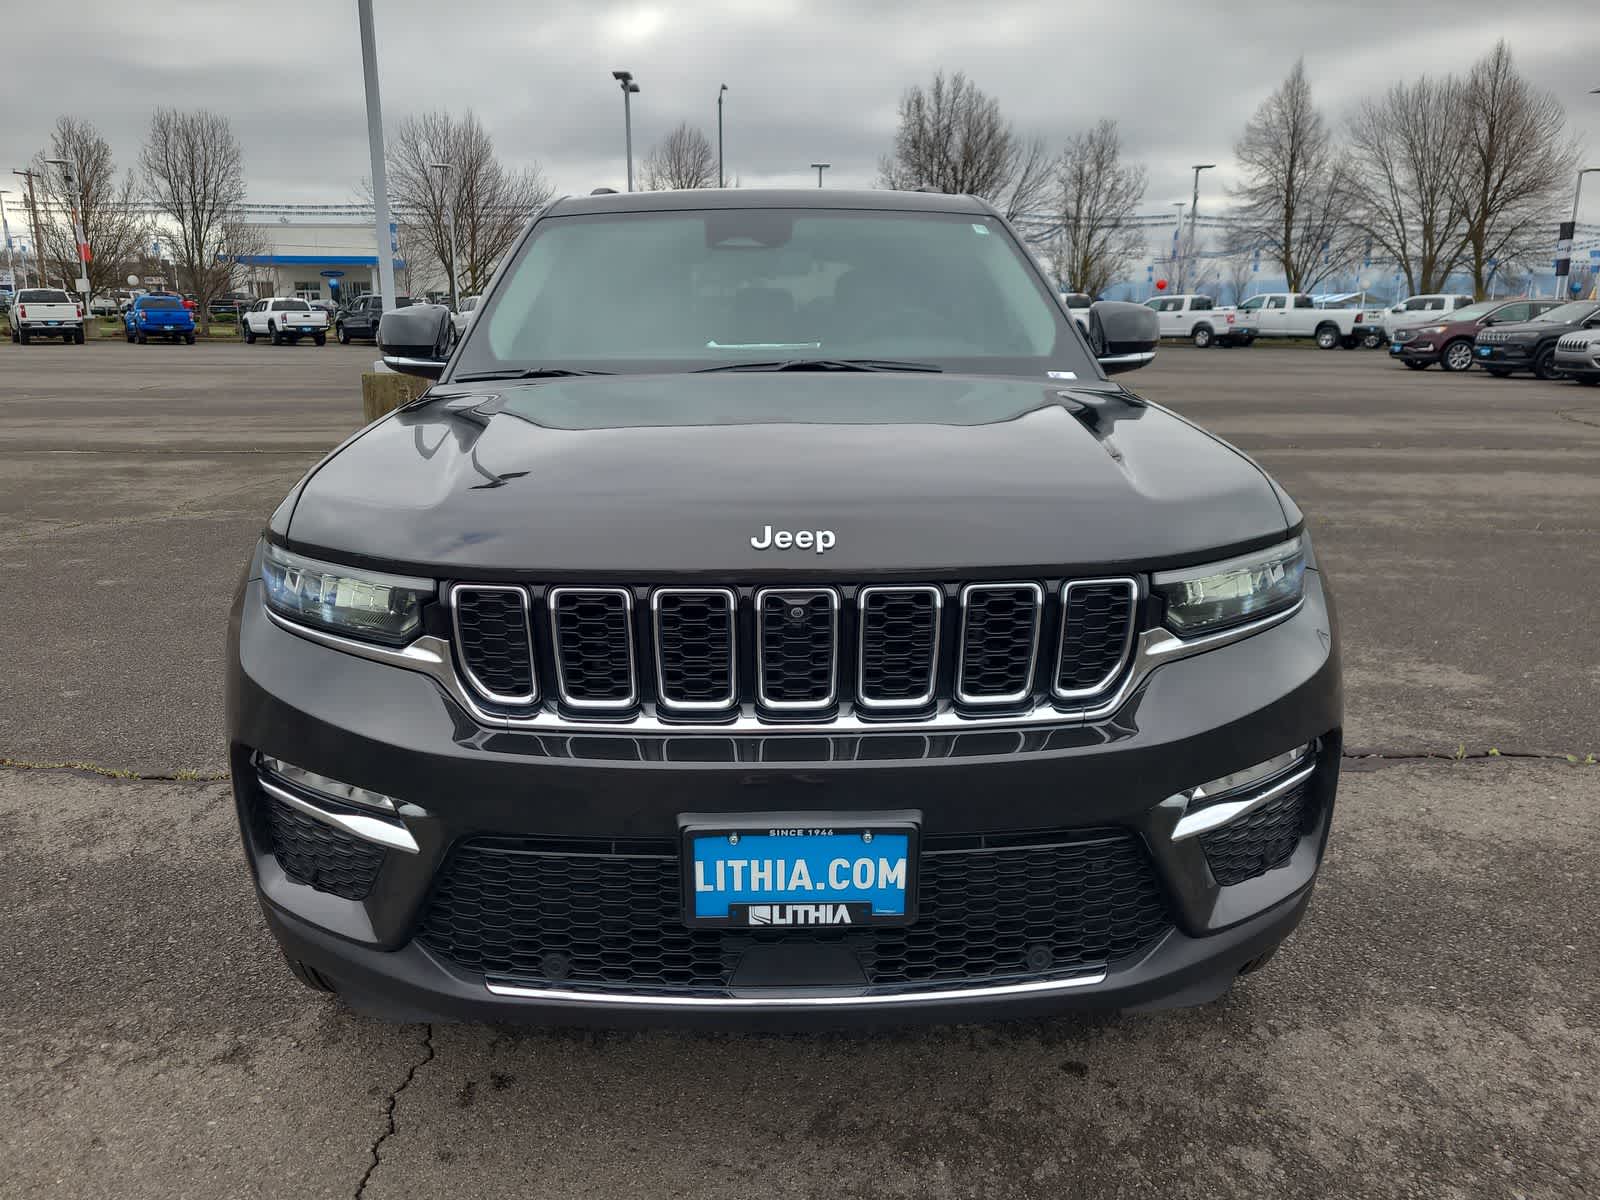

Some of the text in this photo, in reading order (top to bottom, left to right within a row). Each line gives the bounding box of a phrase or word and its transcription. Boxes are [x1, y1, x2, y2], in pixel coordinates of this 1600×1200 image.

[750, 525, 836, 553] Jeep
[769, 829, 834, 837] SINCE 1946
[694, 857, 907, 892] LITHIA.COM
[772, 904, 852, 925] LITHIA
